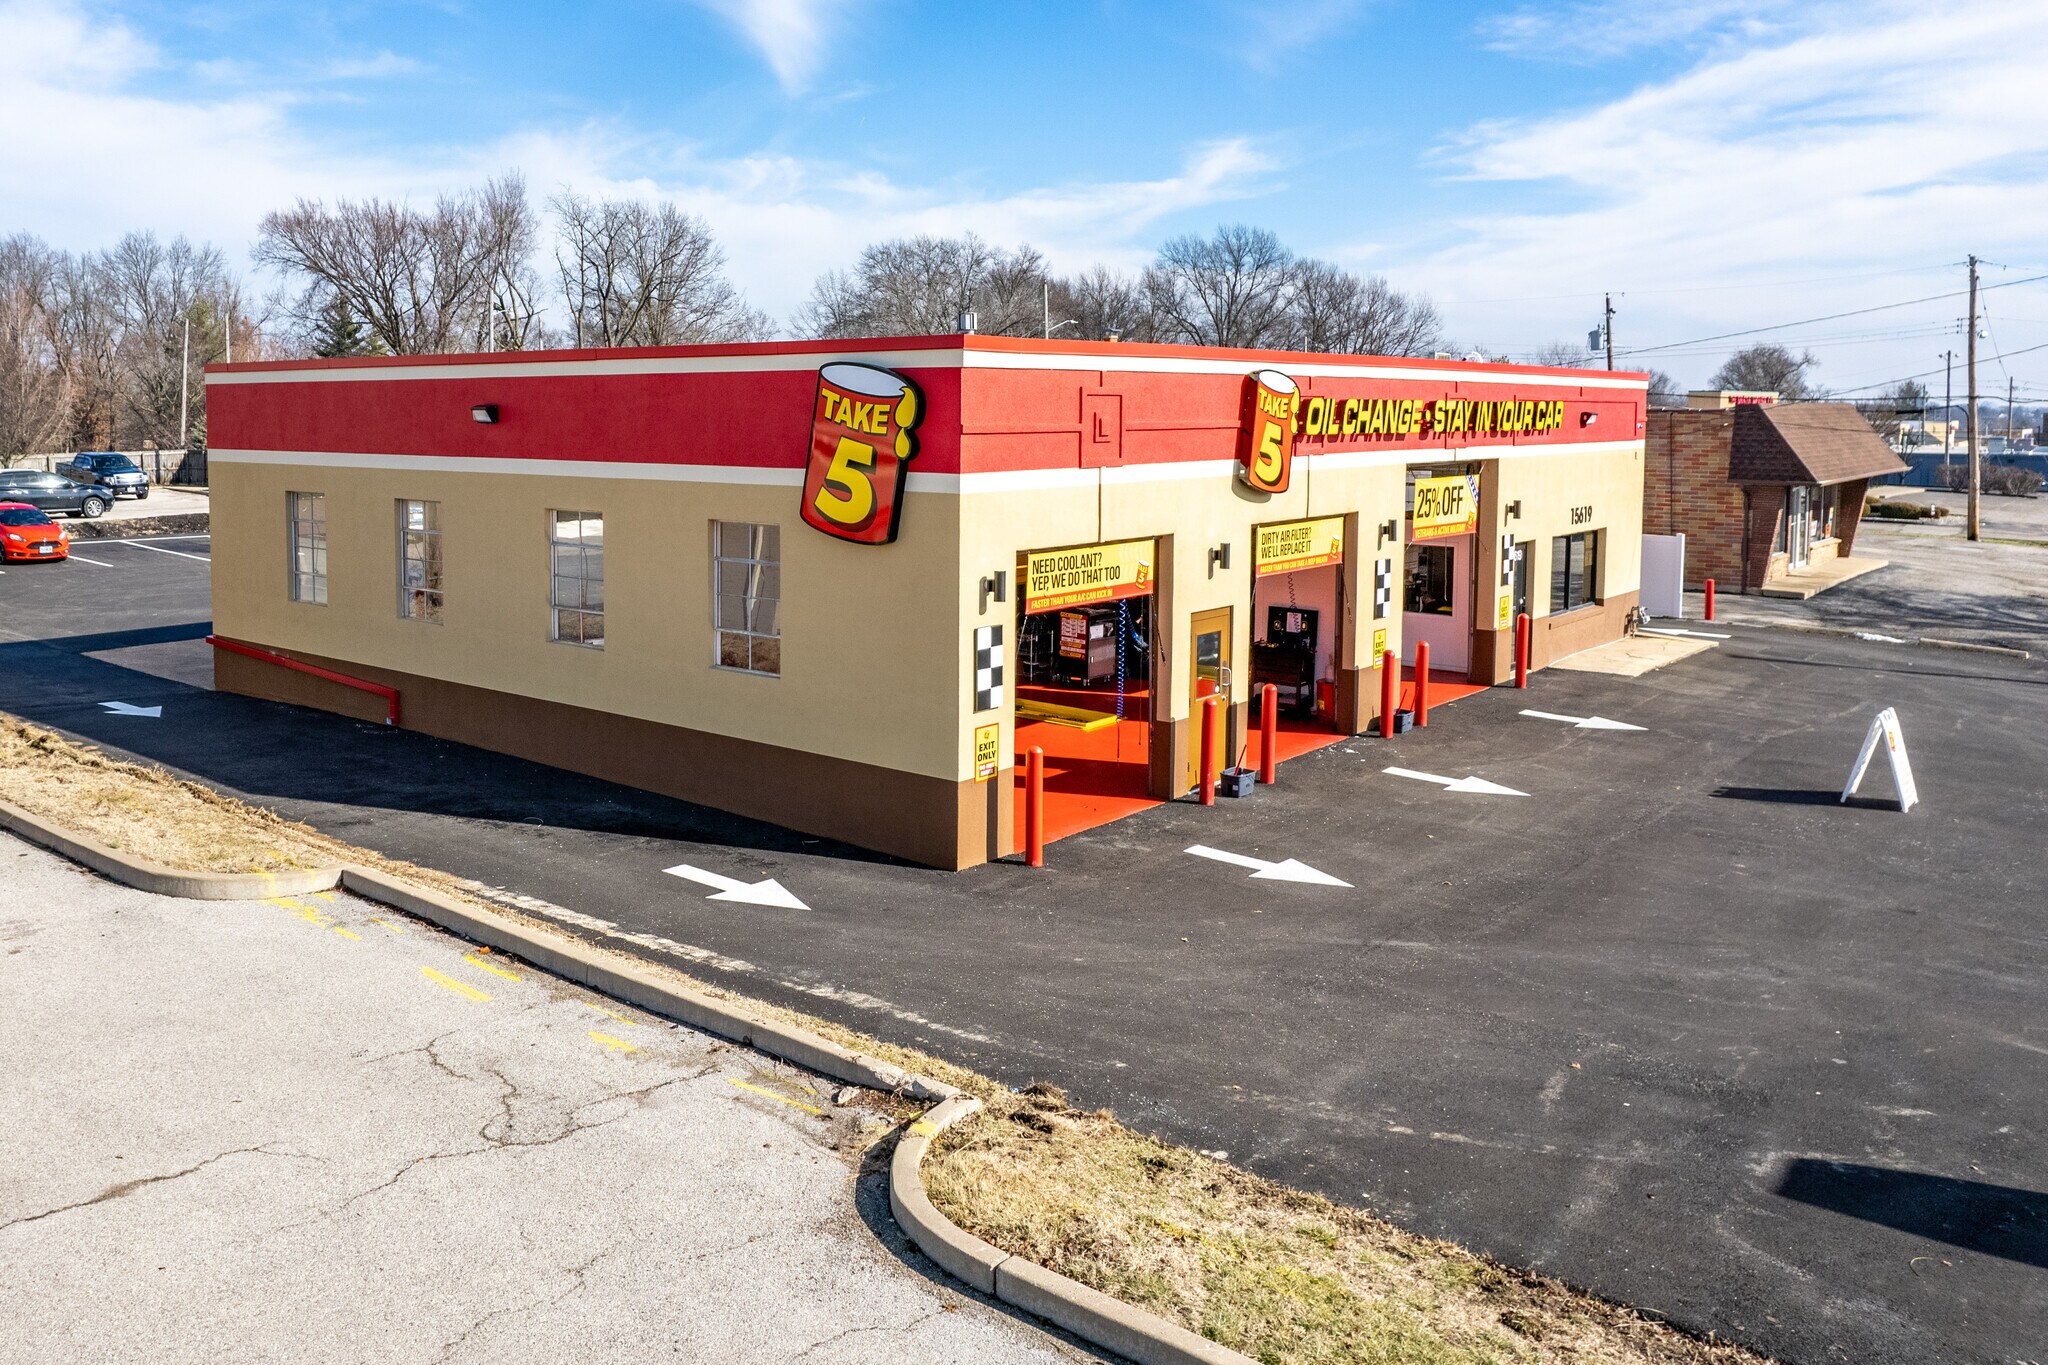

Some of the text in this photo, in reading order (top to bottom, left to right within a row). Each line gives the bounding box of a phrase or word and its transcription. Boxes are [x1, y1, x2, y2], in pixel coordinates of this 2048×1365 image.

[821, 388, 890, 435] TAKE
[1258, 387, 1289, 419] TAKE
[1305, 397, 1564, 435] OIL CHANGE STAY IN YOUR CAR
[1254, 419, 1282, 484] 5
[814, 436, 876, 526] 5
[1416, 485, 1464, 518] 25% OFF
[1570, 505, 1592, 525] 15619
[1261, 527, 1312, 545] DIRTY AIR FILTER?
[1261, 540, 1311, 559] WE'LL REPLACE IT
[1032, 552, 1103, 575] NEED COOLANT?
[1032, 565, 1121, 591] YEP, WE DO THAT TOO
[1138, 572, 1145, 583] 5
[1031, 598, 1050, 609] FASTER
[1050, 596, 1064, 607] THAN
[1064, 594, 1077, 605] YOUR
[1086, 591, 1096, 601] CAN
[977, 749, 996, 762] ONLY
[979, 740, 995, 752] EXIT
